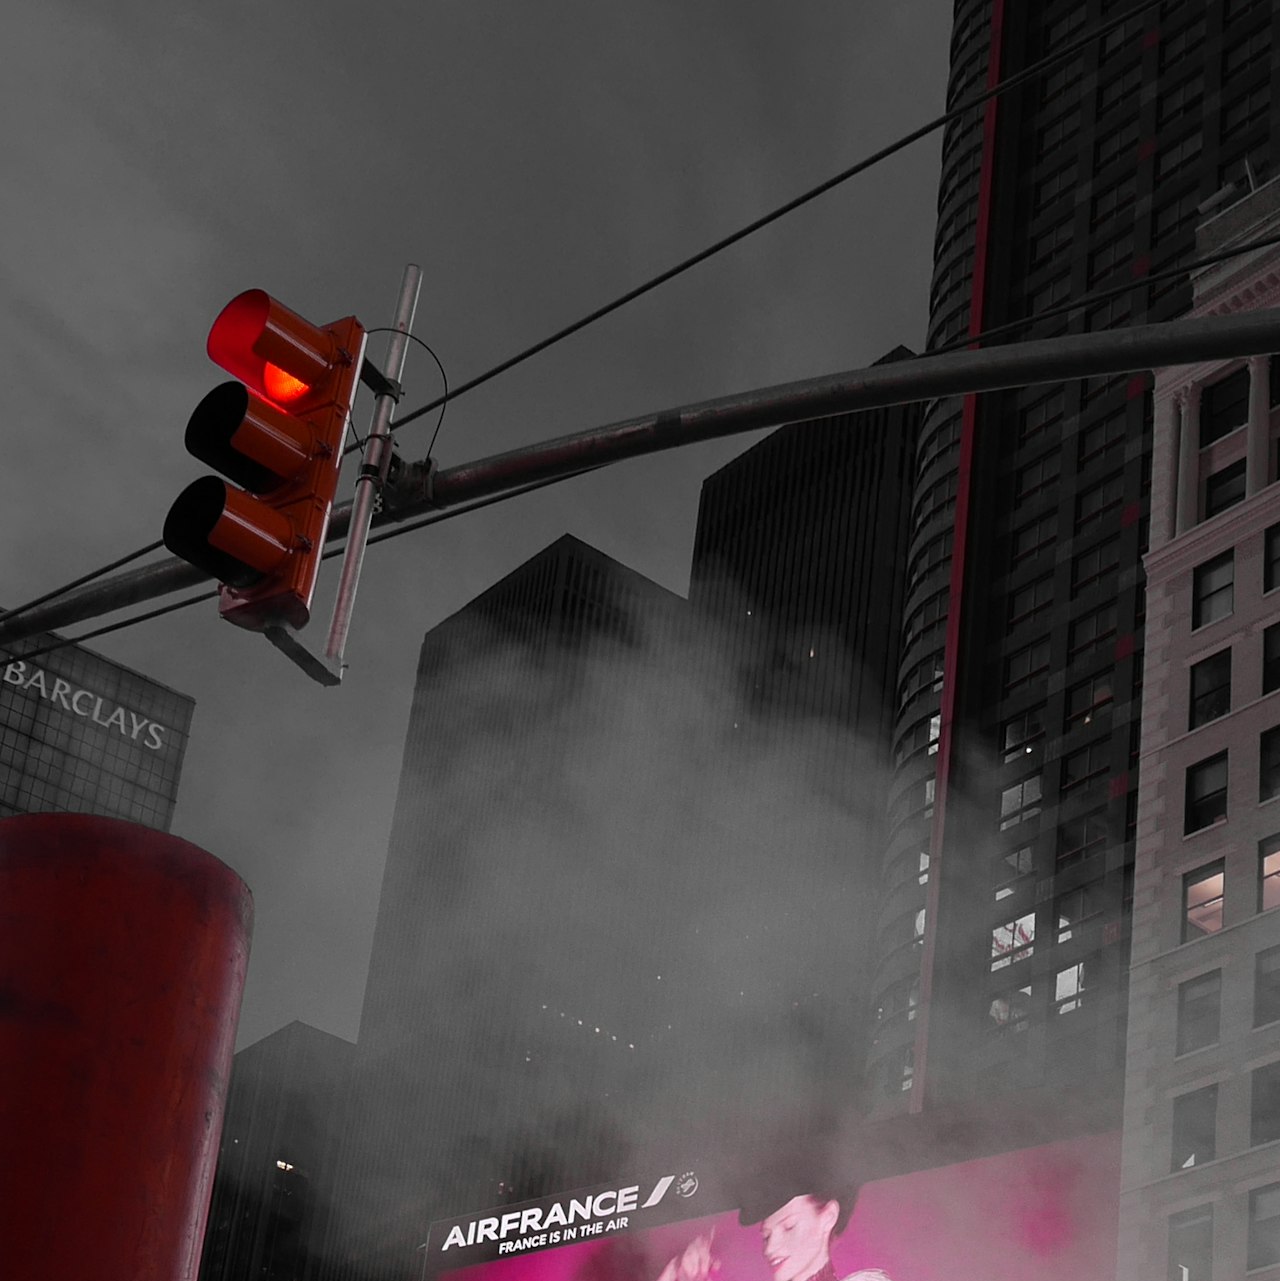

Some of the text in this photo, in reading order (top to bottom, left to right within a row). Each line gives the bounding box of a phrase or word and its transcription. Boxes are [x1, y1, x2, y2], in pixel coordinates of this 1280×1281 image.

[3, 660, 165, 751] BARCLAYS
[441, 1185, 640, 1252] AIRFRANCE
[499, 1216, 629, 1255] FRANCE IS IN THE AIR
